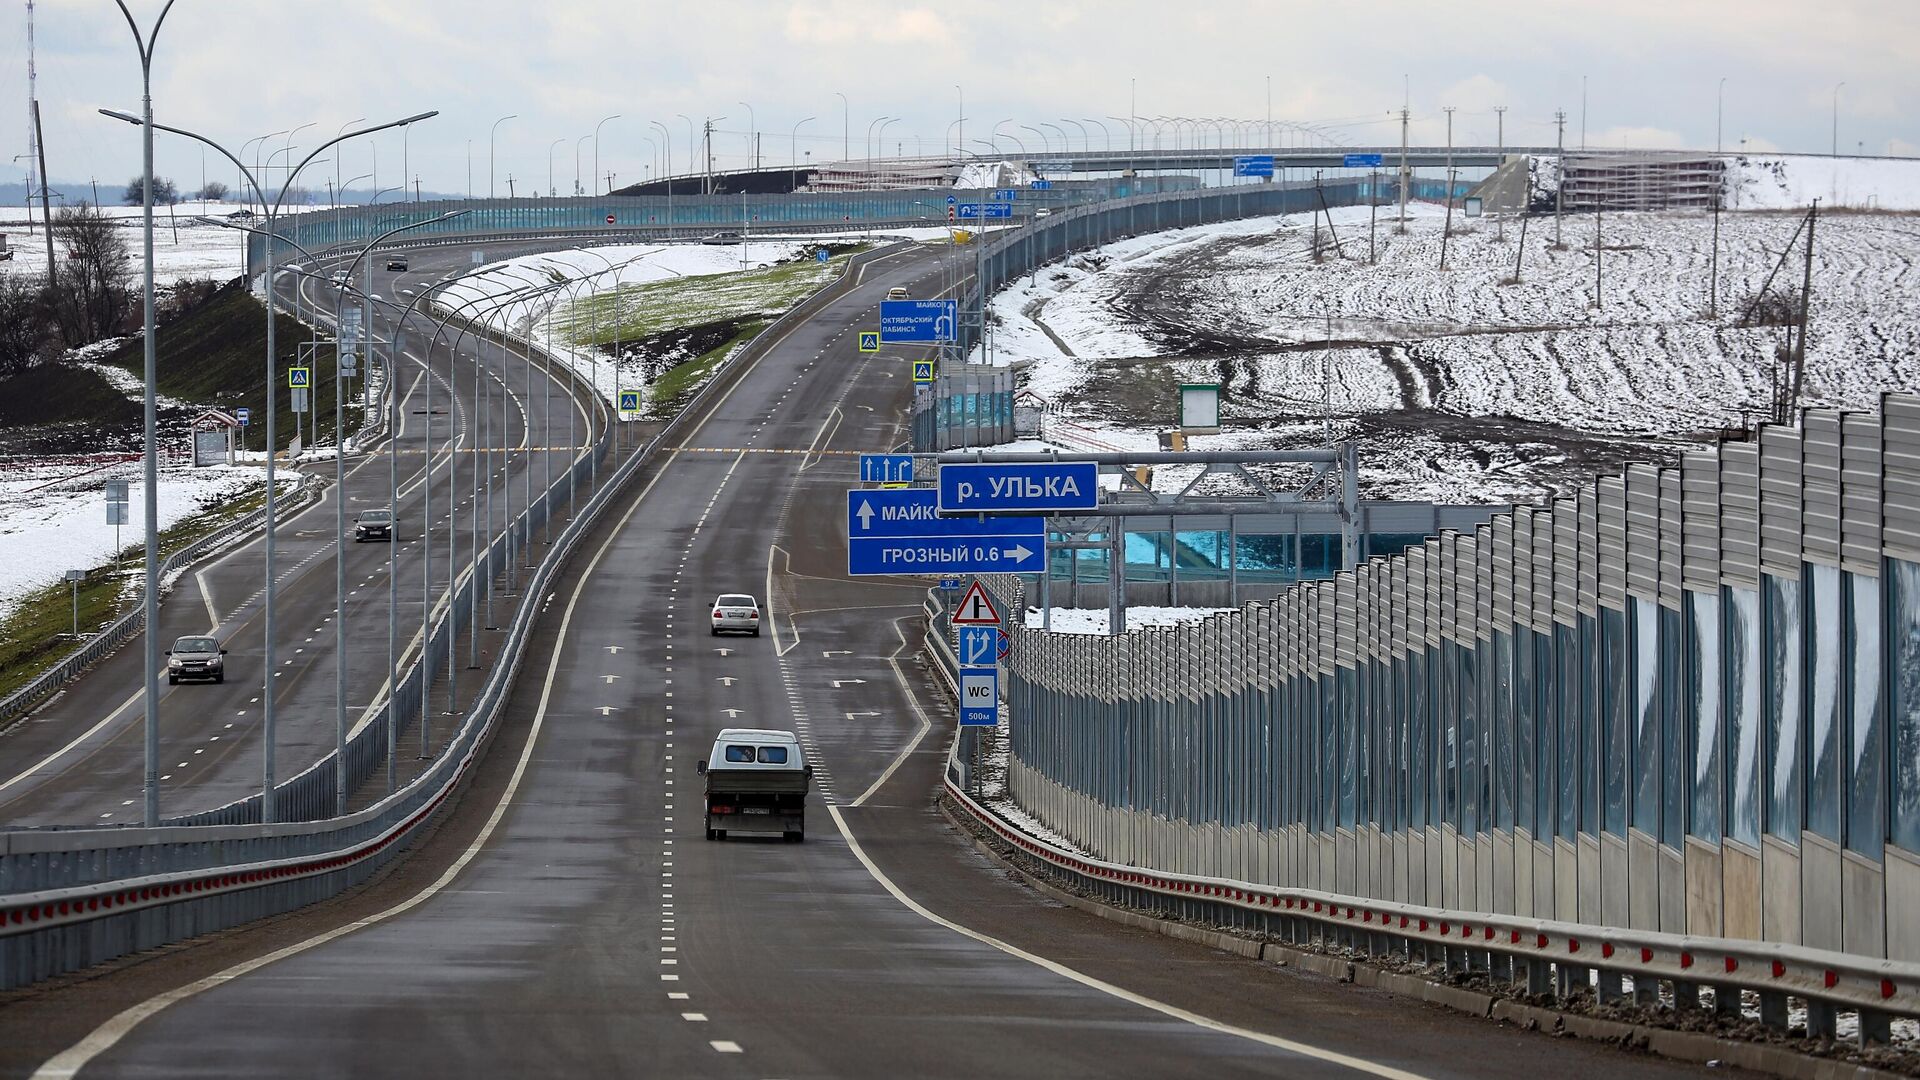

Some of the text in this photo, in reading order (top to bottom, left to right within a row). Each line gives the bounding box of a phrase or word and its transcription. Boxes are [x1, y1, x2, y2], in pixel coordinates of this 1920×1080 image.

[882, 316, 933, 324] ОКТЯБРЬСКИЙ
[958, 476, 1081, 503] р. УЛЬКА
[882, 545, 999, 563] ГРОЗНЫЙ 0.6
[968, 686, 990, 698] WC
[968, 712, 990, 720] 500м
